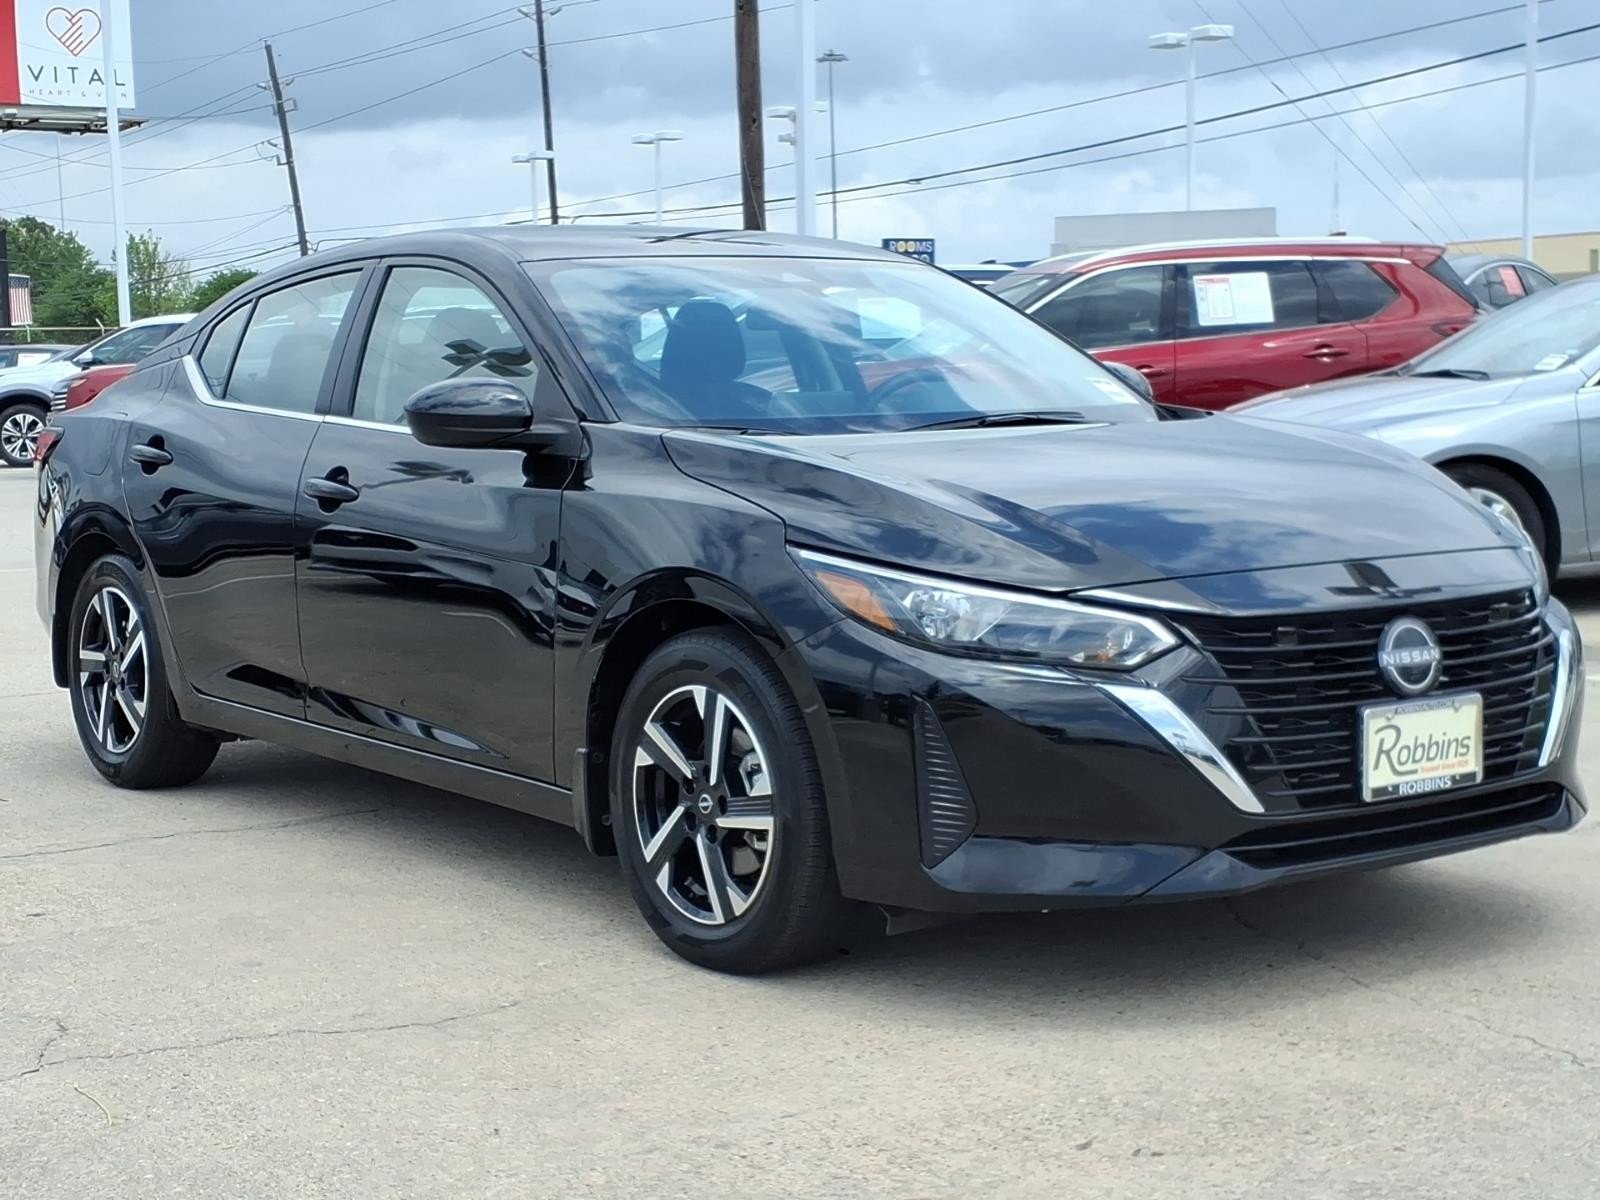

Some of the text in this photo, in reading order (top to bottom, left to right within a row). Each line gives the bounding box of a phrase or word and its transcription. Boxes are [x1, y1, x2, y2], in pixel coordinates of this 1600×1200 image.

[27, 64, 126, 87] VITAL
[29, 89, 71, 97] HEART
[889, 240, 933, 253] ROOMS
[1382, 649, 1440, 665] NISSAN
[1373, 724, 1471, 777] Robbins
[1399, 775, 1452, 796] ROBBINS
